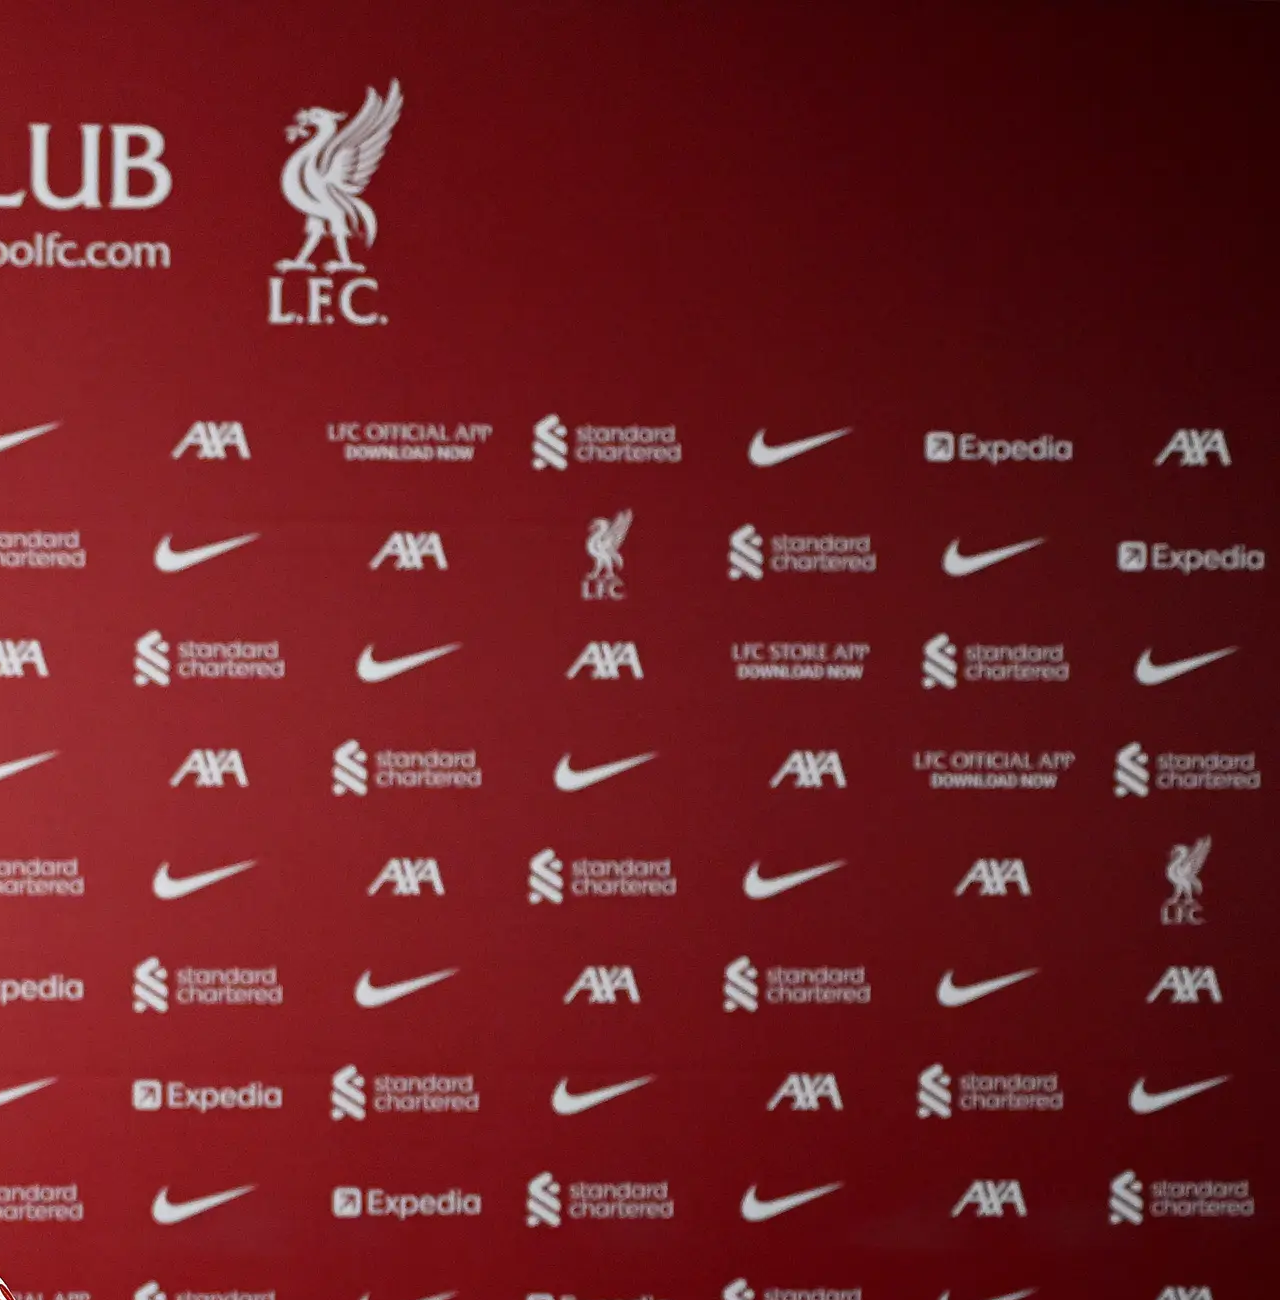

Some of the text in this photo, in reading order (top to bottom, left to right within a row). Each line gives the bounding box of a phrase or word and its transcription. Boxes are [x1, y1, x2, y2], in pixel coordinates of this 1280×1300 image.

[268, 277, 389, 325] L.F.C.
[172, 421, 250, 459] AXA
[958, 433, 1073, 465] Expedia
[1155, 429, 1232, 466] AXA
[370, 532, 447, 570] AXA
[770, 534, 868, 554] standard
[1151, 542, 1265, 575] Expedia
[769, 552, 876, 572] chartered
[567, 641, 644, 679] AXA
[964, 643, 1062, 663] standard
[964, 661, 1070, 681] chartered
[170, 749, 248, 787] AXA
[770, 750, 846, 788] AXA
[368, 858, 444, 895] AXA
[564, 966, 640, 1004] AXA
[766, 966, 863, 986] standard
[765, 984, 871, 1004] chartered
[166, 1081, 282, 1113] Expedia
[374, 1074, 472, 1094] standard
[767, 1073, 843, 1111] AXA
[373, 1092, 480, 1112] chartered
